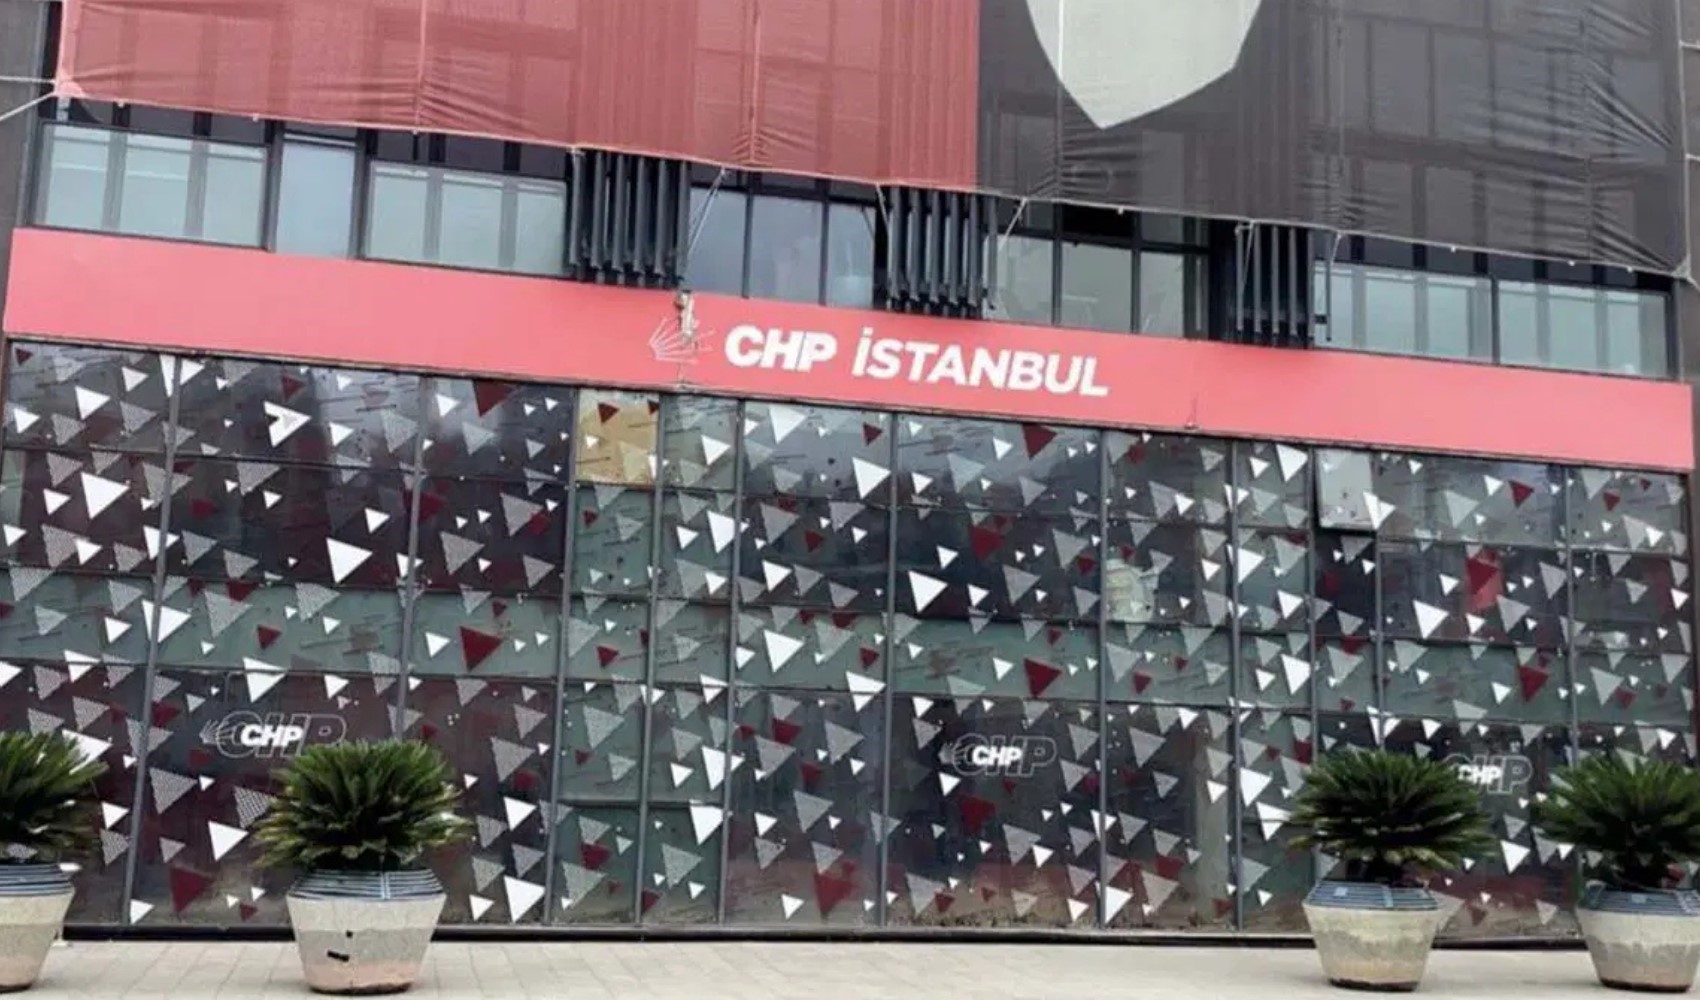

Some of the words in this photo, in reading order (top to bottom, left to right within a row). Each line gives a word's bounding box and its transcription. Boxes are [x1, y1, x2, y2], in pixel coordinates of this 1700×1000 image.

[725, 325, 837, 372] CHP
[851, 327, 1108, 397] İSTANBUL
[240, 724, 303, 747] CHP
[972, 745, 1022, 766] CHP
[1457, 764, 1501, 784] CHP
